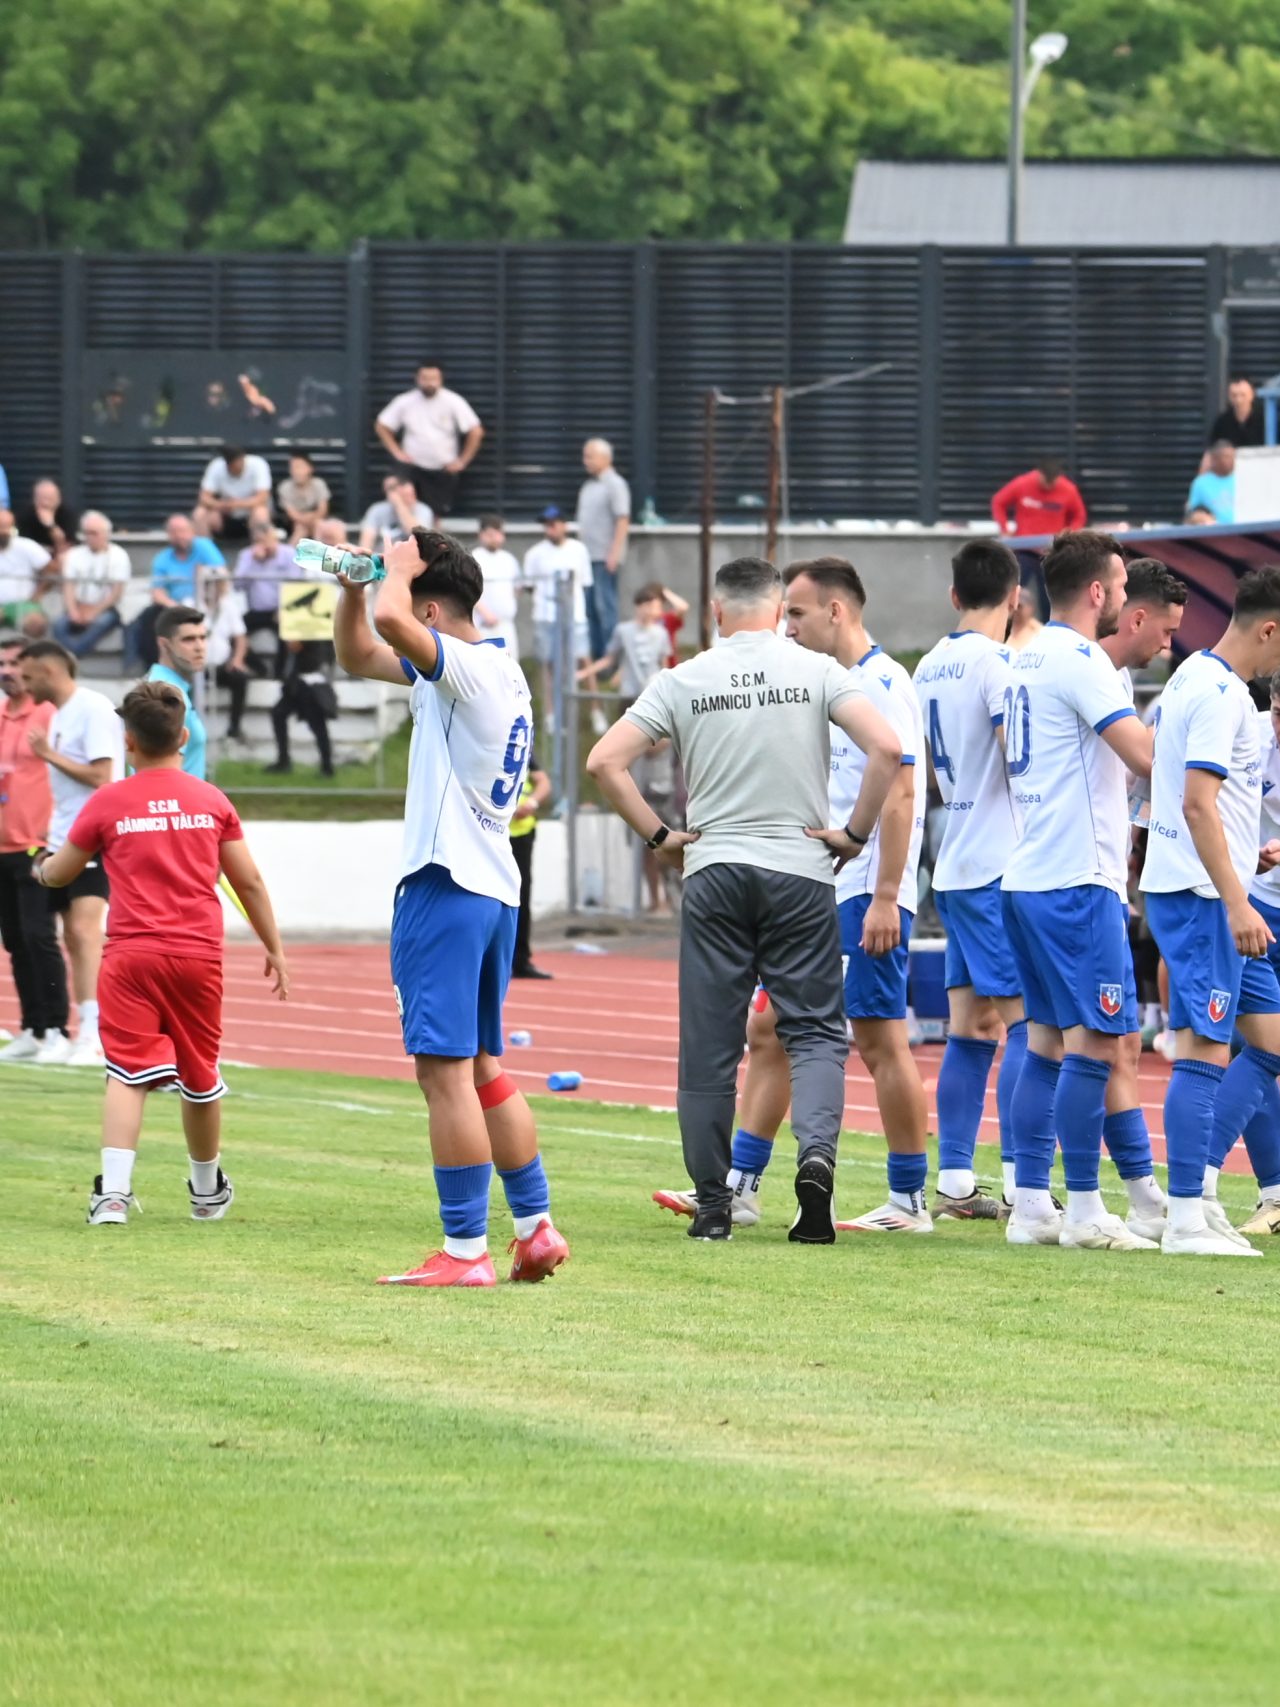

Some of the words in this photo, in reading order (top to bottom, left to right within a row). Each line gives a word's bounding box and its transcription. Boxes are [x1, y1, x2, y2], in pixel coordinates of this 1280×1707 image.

[730, 671, 768, 688] S.C.M.
[691, 693, 751, 715] RÂMNICU
[757, 686, 810, 707] VÂLCEA
[116, 816, 168, 835] RÂMNICU
[170, 812, 215, 830] VÂLCEA
